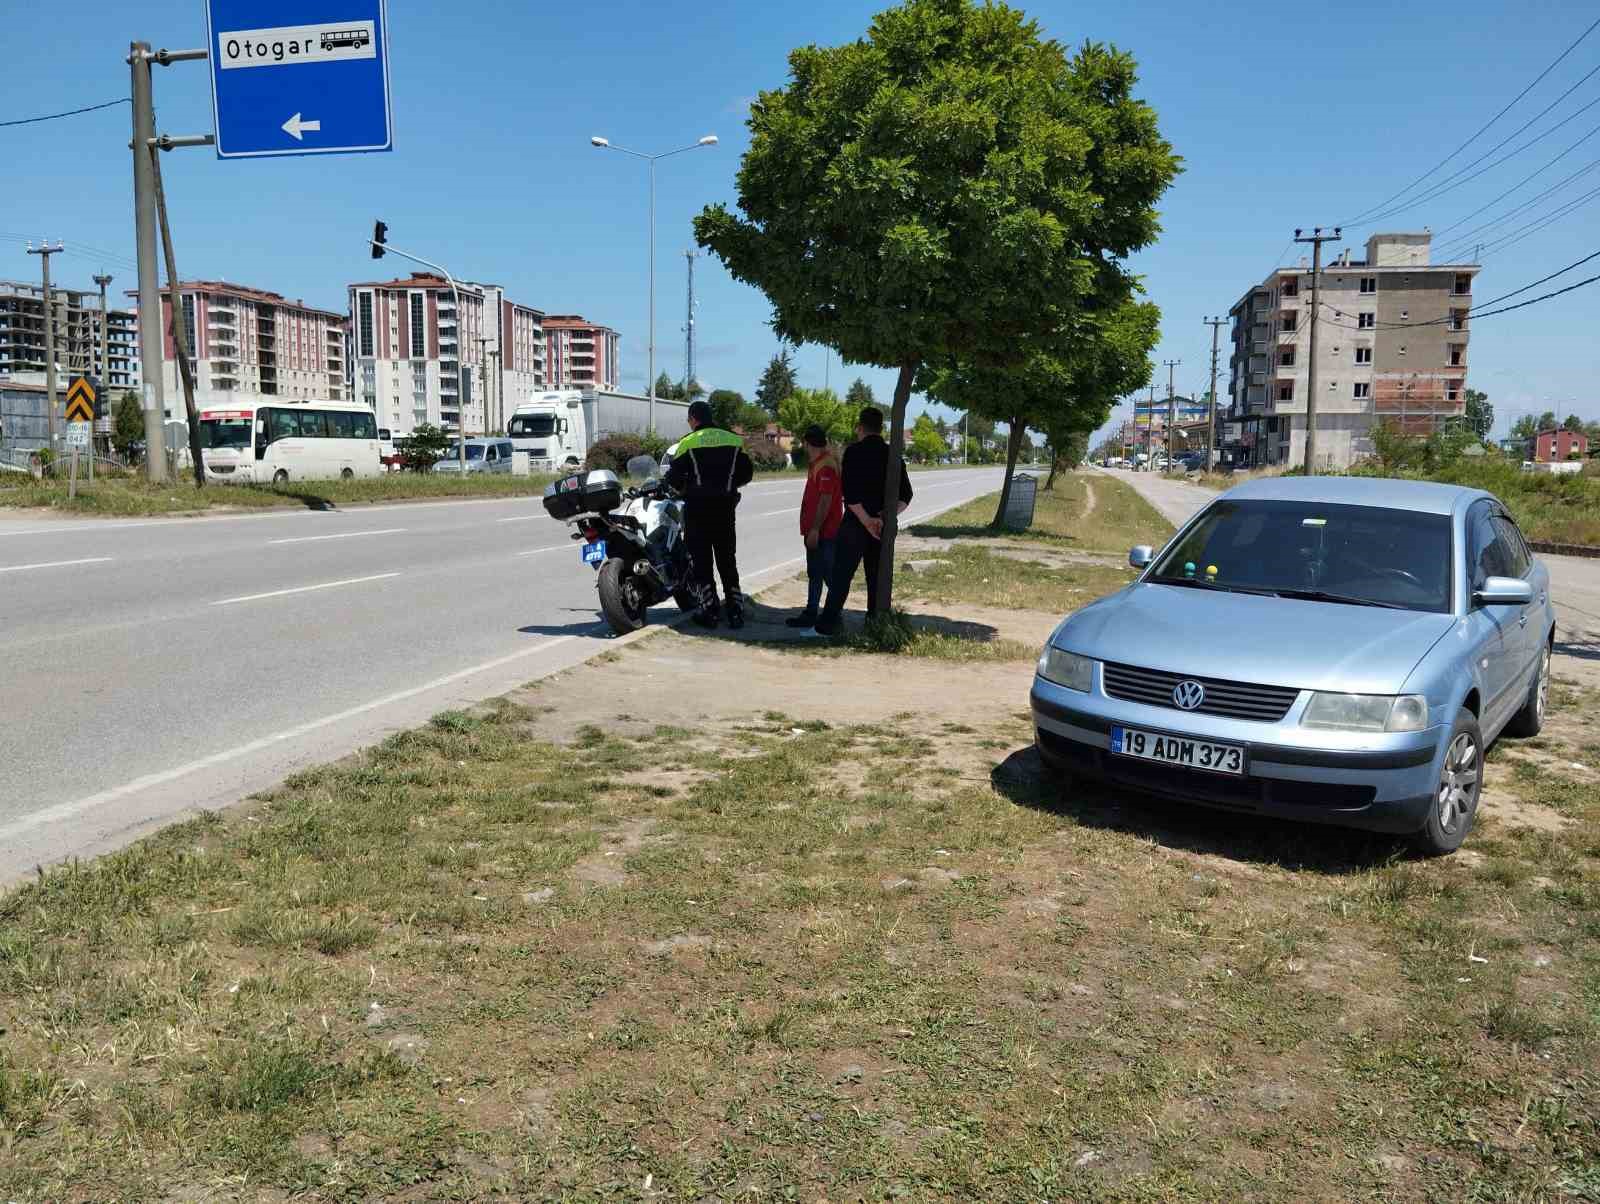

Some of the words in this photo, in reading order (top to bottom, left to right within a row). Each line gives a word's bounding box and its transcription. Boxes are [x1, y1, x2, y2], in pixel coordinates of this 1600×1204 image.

[226, 39, 313, 61] Otogar
[1125, 731, 1146, 754] 19
[1152, 736, 1195, 763] ADM
[1199, 744, 1241, 771] 373
